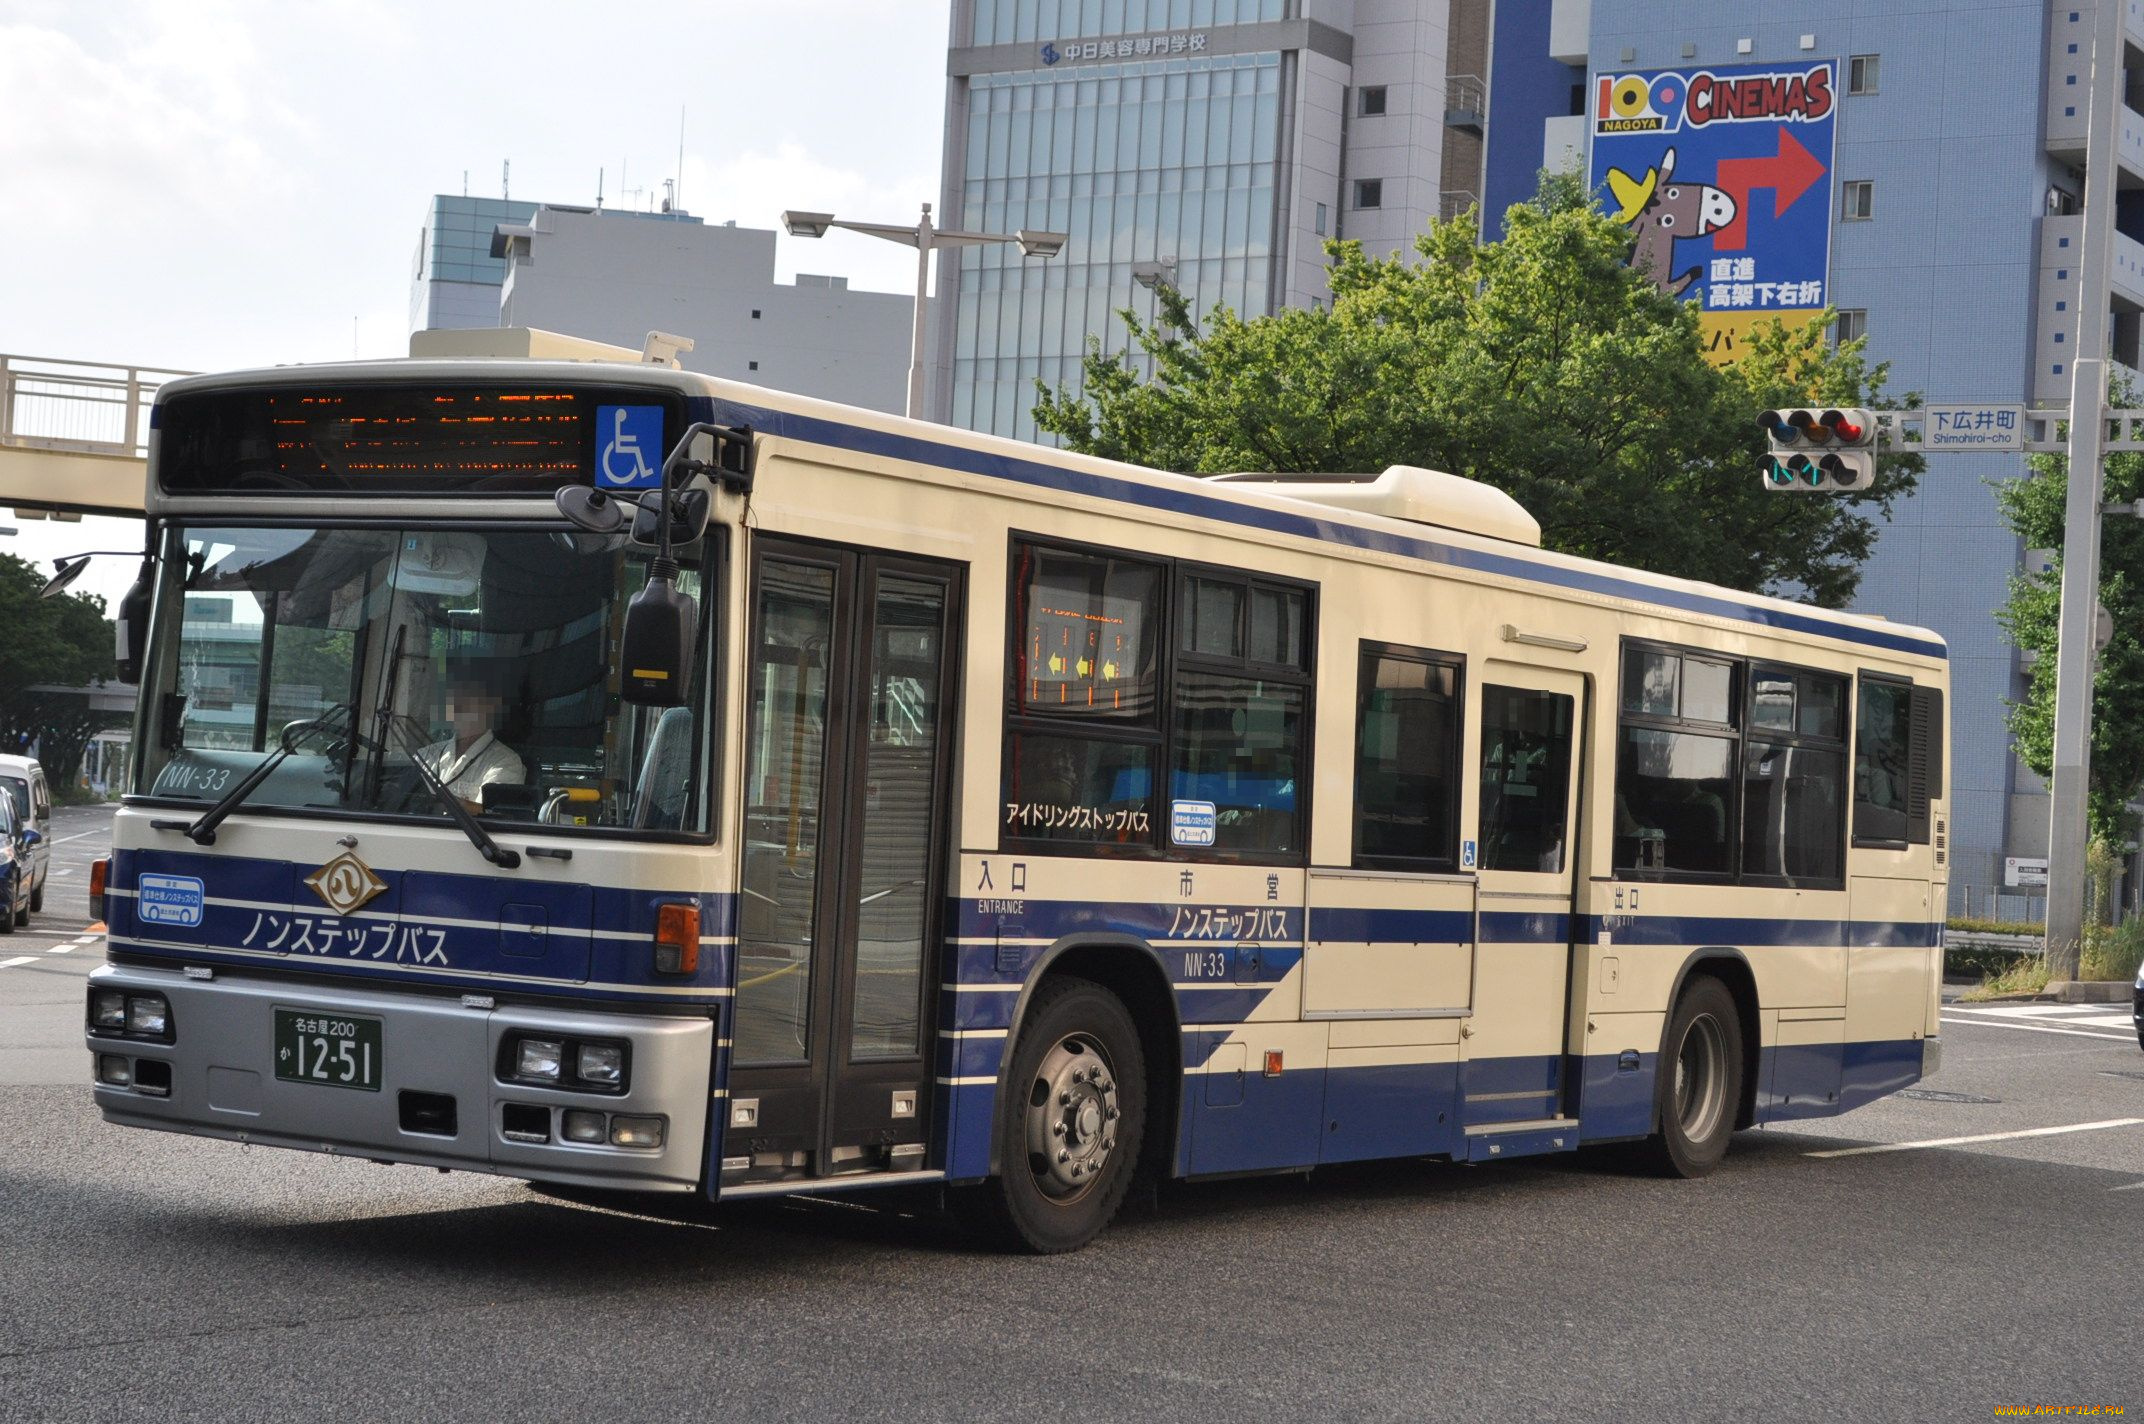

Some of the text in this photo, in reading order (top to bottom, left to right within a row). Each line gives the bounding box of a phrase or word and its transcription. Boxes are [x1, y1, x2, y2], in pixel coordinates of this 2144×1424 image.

[1065, 34, 1206, 61] 中日美容専門学校
[1598, 68, 1832, 130] 109 CINEMAS
[1603, 119, 1658, 132] NAGOYA
[1711, 257, 1755, 282] 直進
[1709, 281, 1822, 307] 高架下右折
[1932, 410, 2016, 430] 下広井町
[1933, 433, 2011, 444] Shimohiroi-cho
[162, 765, 231, 791] NN-33
[1006, 803, 1149, 832] アイドリングストップバス
[978, 860, 1026, 892] 入口
[978, 899, 1024, 915] ENTRANCE
[1615, 886, 1638, 910] 出口
[1168, 906, 1288, 940] ノンステップバス
[242, 912, 449, 966] ノンステップバス
[1184, 953, 1225, 977] NN-33
[280, 1035, 370, 1084] か 12-51
